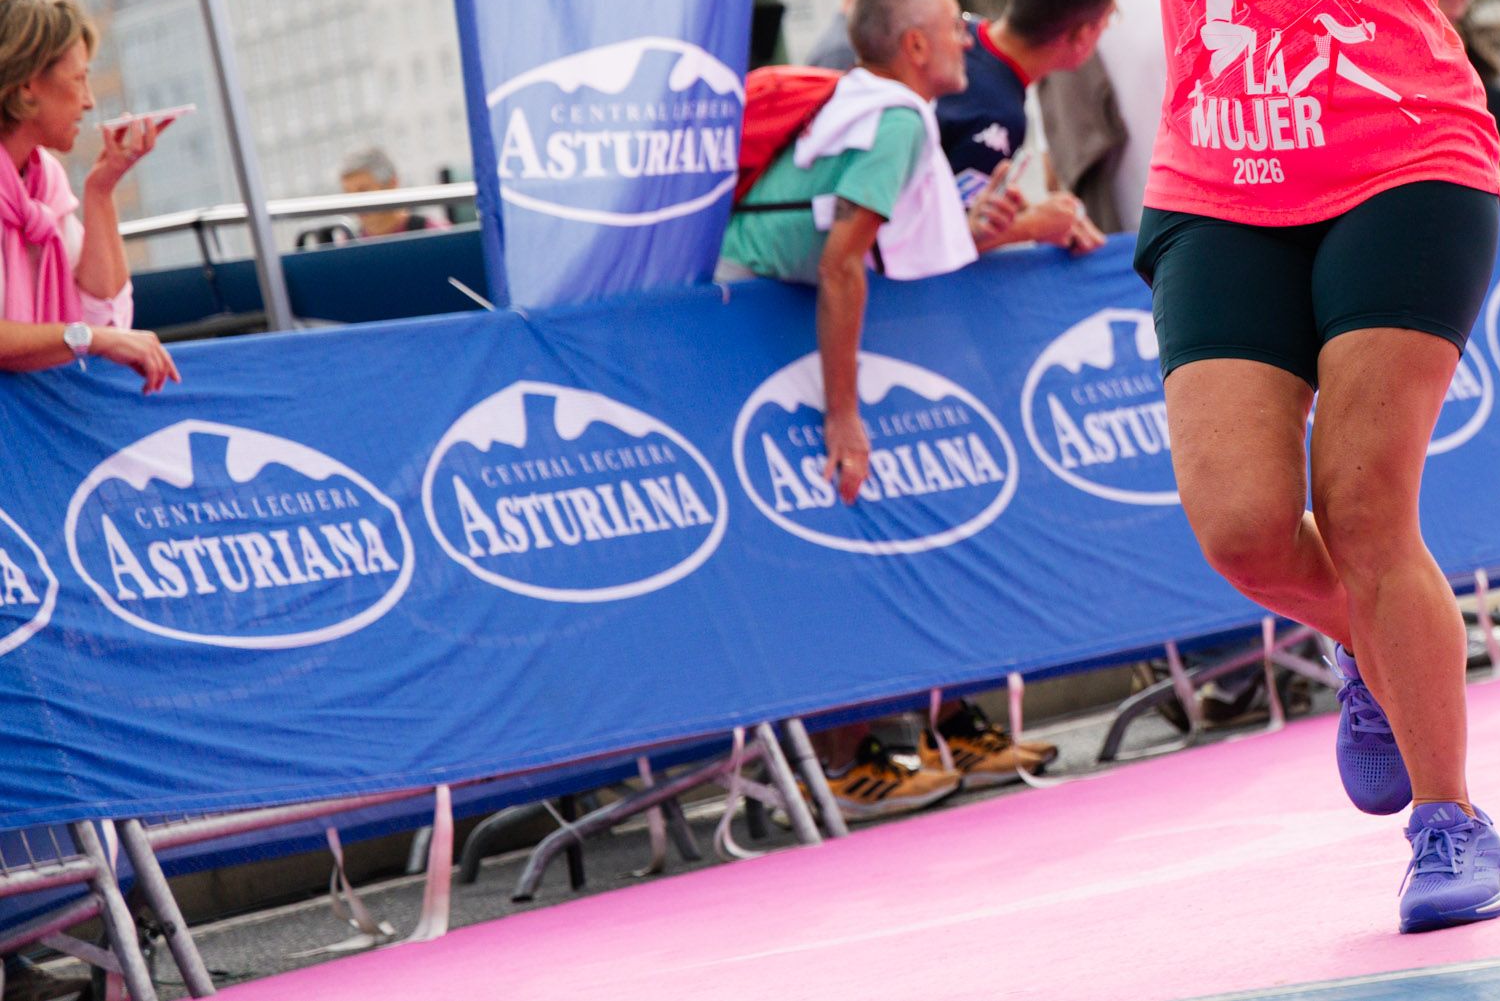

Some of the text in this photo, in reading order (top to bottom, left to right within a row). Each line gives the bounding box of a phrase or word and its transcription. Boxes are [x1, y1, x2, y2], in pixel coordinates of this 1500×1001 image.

[551, 102, 668, 125] CENTRAL
[1190, 95, 1326, 152] MUJER
[497, 107, 738, 180] ASTURIANA
[1232, 157, 1285, 185] 2026
[480, 455, 576, 488] CENTRAL
[134, 486, 361, 530] CENTRAL LECHERA
[452, 472, 714, 559] ASTURIANA
[101, 513, 400, 602] ASTURIANA
